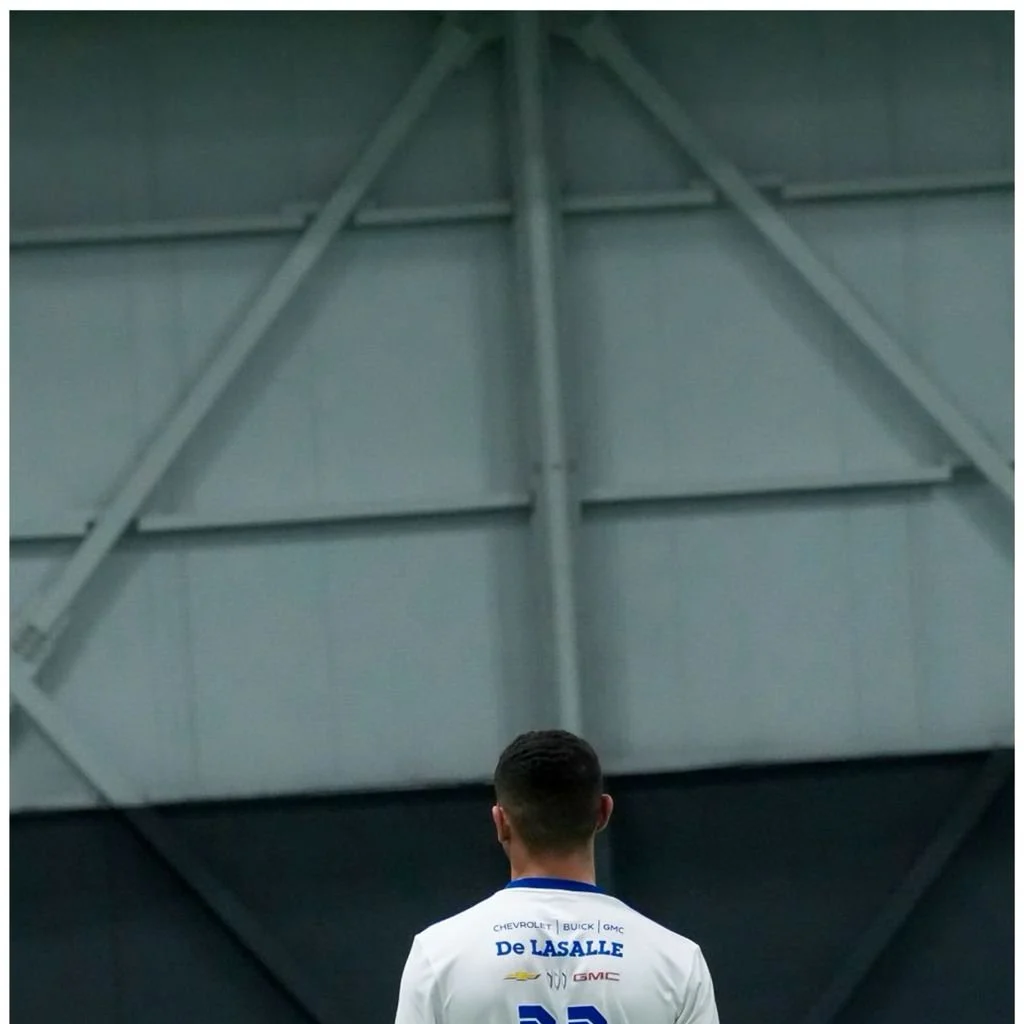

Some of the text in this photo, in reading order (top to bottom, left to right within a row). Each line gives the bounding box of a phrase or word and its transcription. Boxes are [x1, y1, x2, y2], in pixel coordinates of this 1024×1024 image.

[493, 921, 624, 934] CHEVROLET BUICK GMC
[496, 939, 624, 957] De LASALLE
[573, 971, 620, 982] GMC
